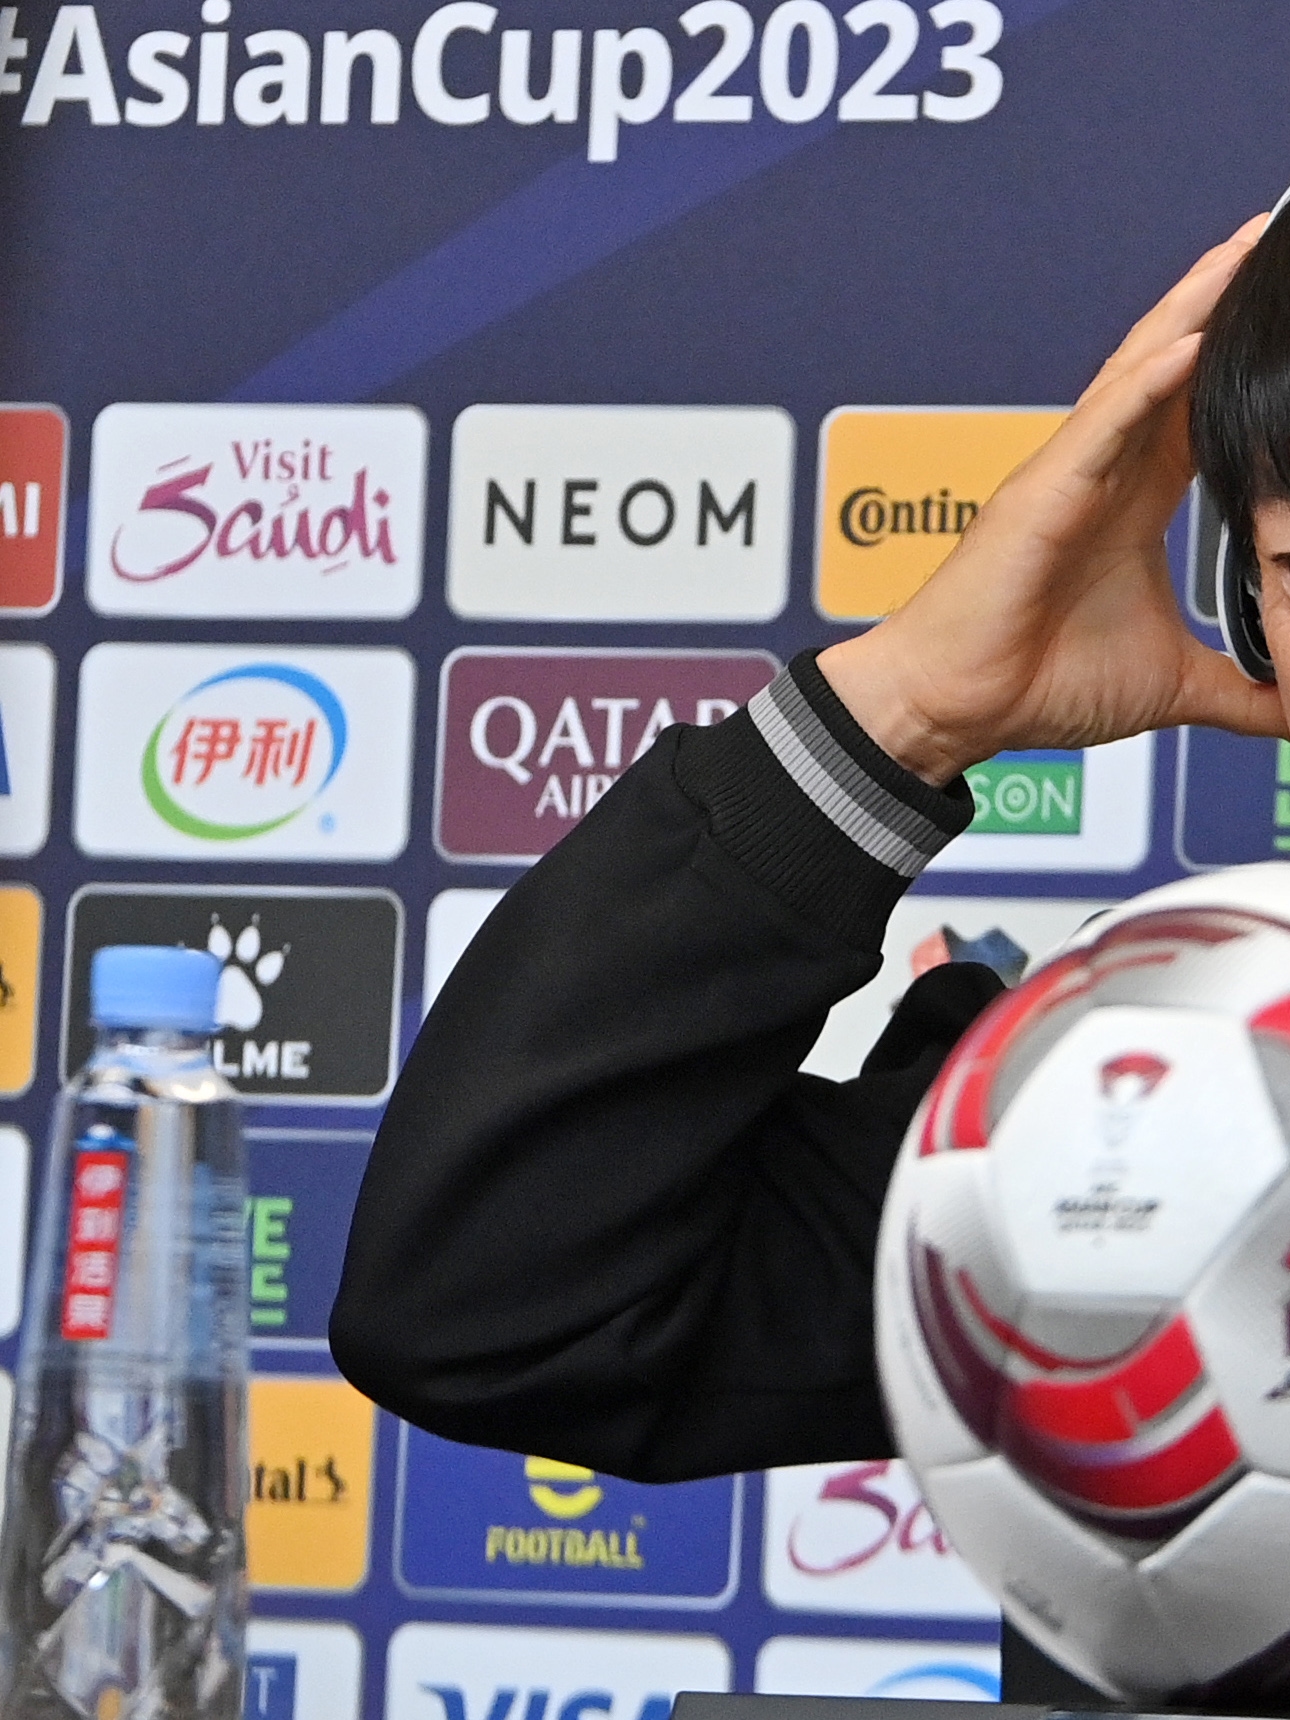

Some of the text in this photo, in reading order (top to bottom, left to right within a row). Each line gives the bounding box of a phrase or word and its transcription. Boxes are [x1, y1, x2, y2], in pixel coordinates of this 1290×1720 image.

[231, 439, 334, 480] Visit
[110, 457, 398, 583] Saudi
[483, 478, 757, 548] NEOM
[172, 717, 318, 787] 伊利
[485, 1525, 644, 1569] FOOTBALL
